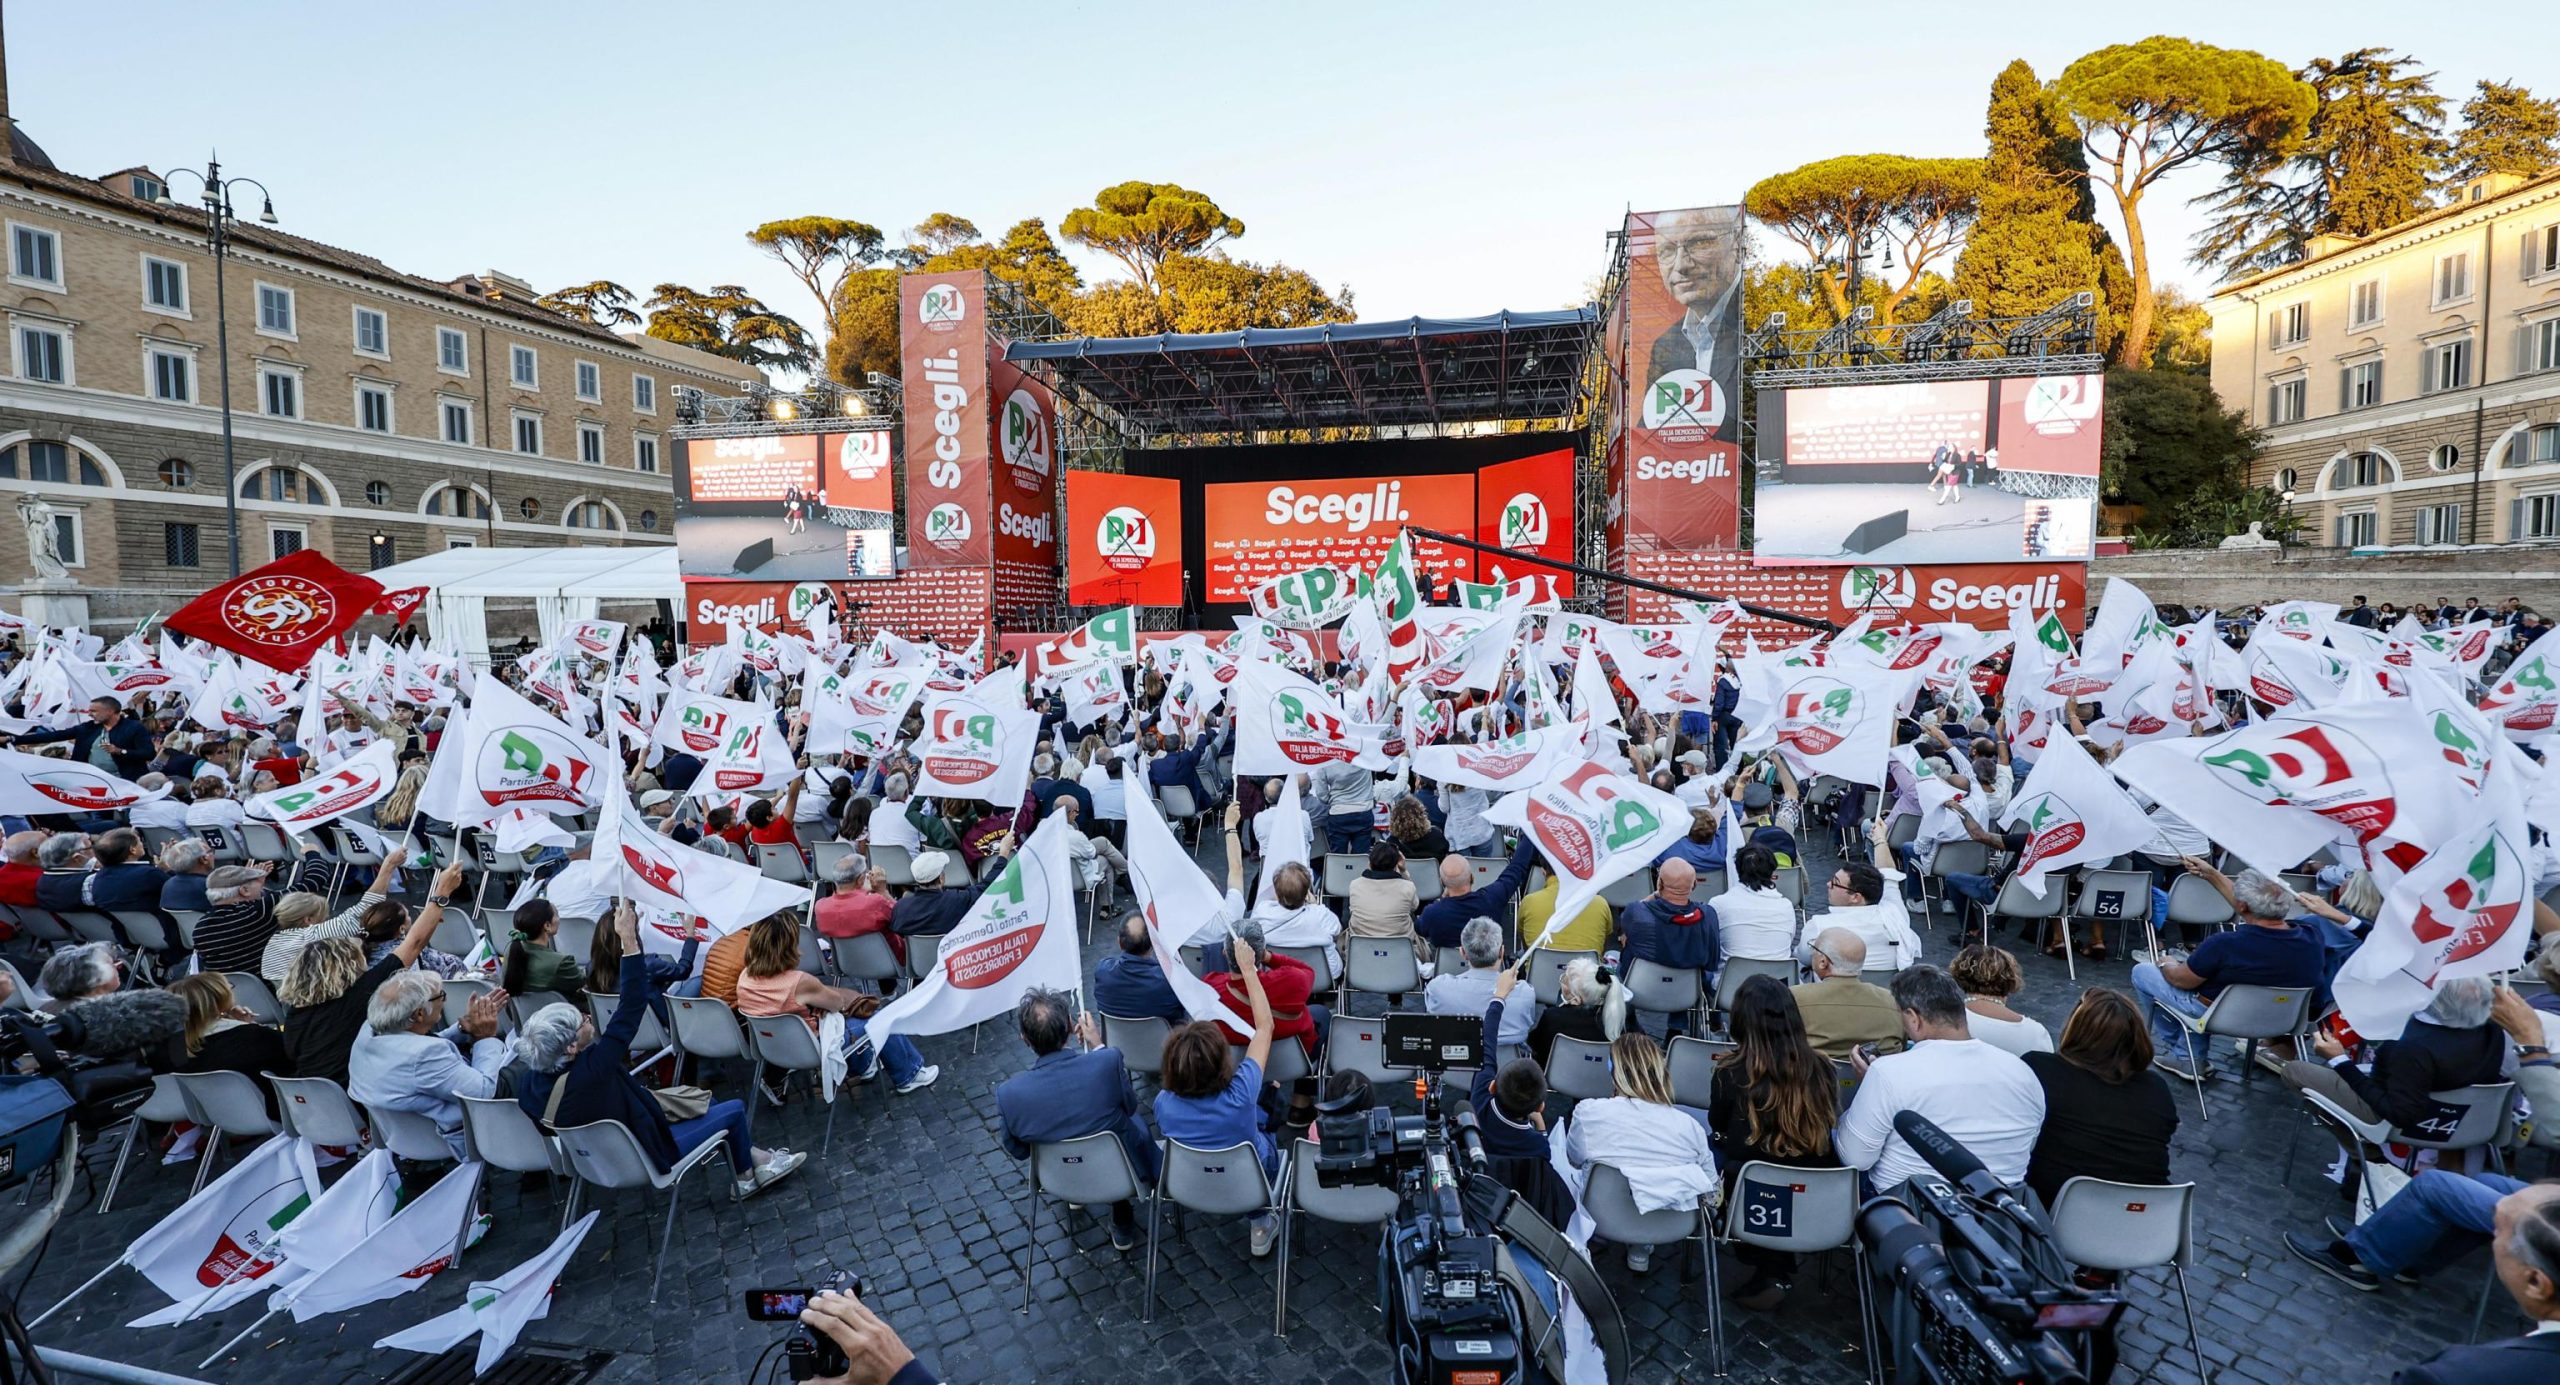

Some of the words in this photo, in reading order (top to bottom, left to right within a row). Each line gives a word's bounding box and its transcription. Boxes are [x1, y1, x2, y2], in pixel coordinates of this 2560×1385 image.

[1656, 380, 1712, 414] PD
[923, 348, 967, 489] Scegli.
[1636, 452, 1731, 484] Scegli.
[1265, 480, 1409, 532] Scegli.
[1000, 503, 1053, 548] Scegli.
[1928, 574, 2066, 616] Scegli.
[698, 597, 781, 628] Scegli.
[1290, 745, 1308, 753] ITALIA
[500, 777, 533, 787] Partito
[207, 838, 222, 848] 19
[482, 850, 494, 861] 32
[2098, 902, 2120, 914] 56
[2417, 1117, 2459, 1134] 44
[1760, 1191, 1776, 1199] FILA
[1749, 1204, 1786, 1228] 31
[1984, 1338, 2012, 1366] SONY
